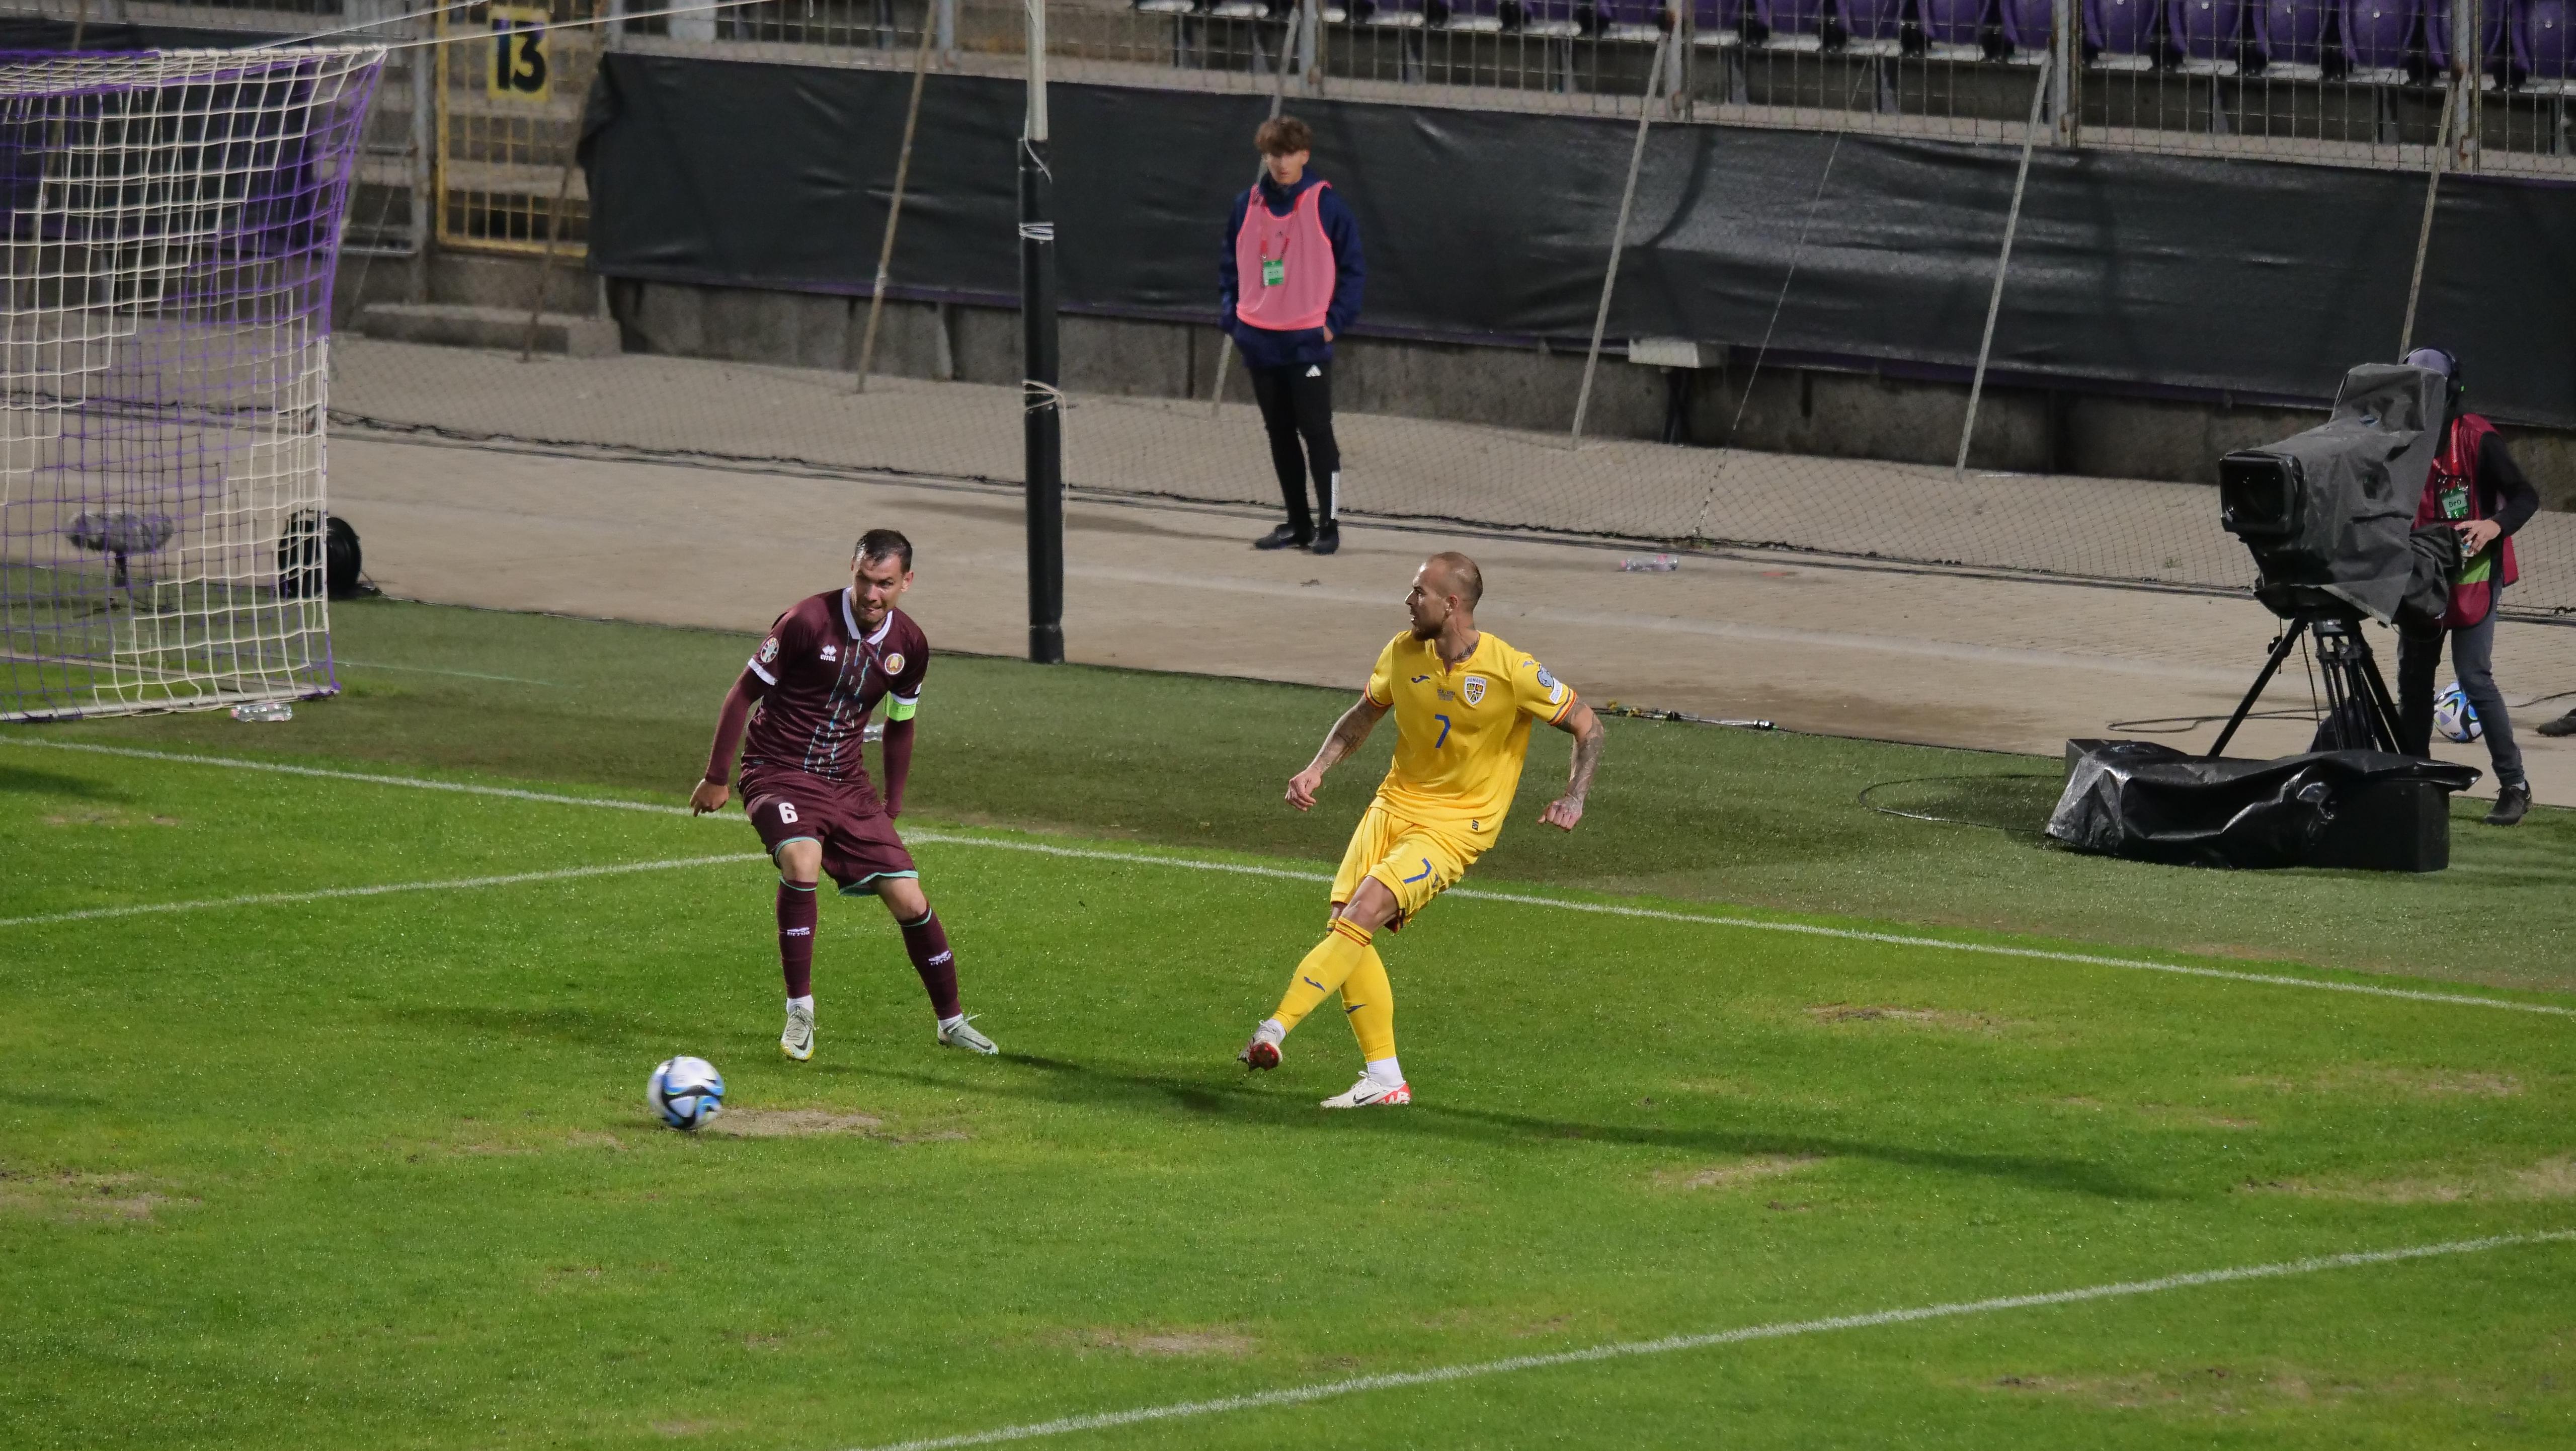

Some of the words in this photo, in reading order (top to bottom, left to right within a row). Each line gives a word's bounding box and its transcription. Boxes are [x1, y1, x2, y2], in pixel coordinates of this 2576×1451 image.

[493, 19, 546, 93] 13
[1434, 714, 1451, 748] 7
[778, 802, 798, 824] 6
[1403, 858, 1432, 884] 7
